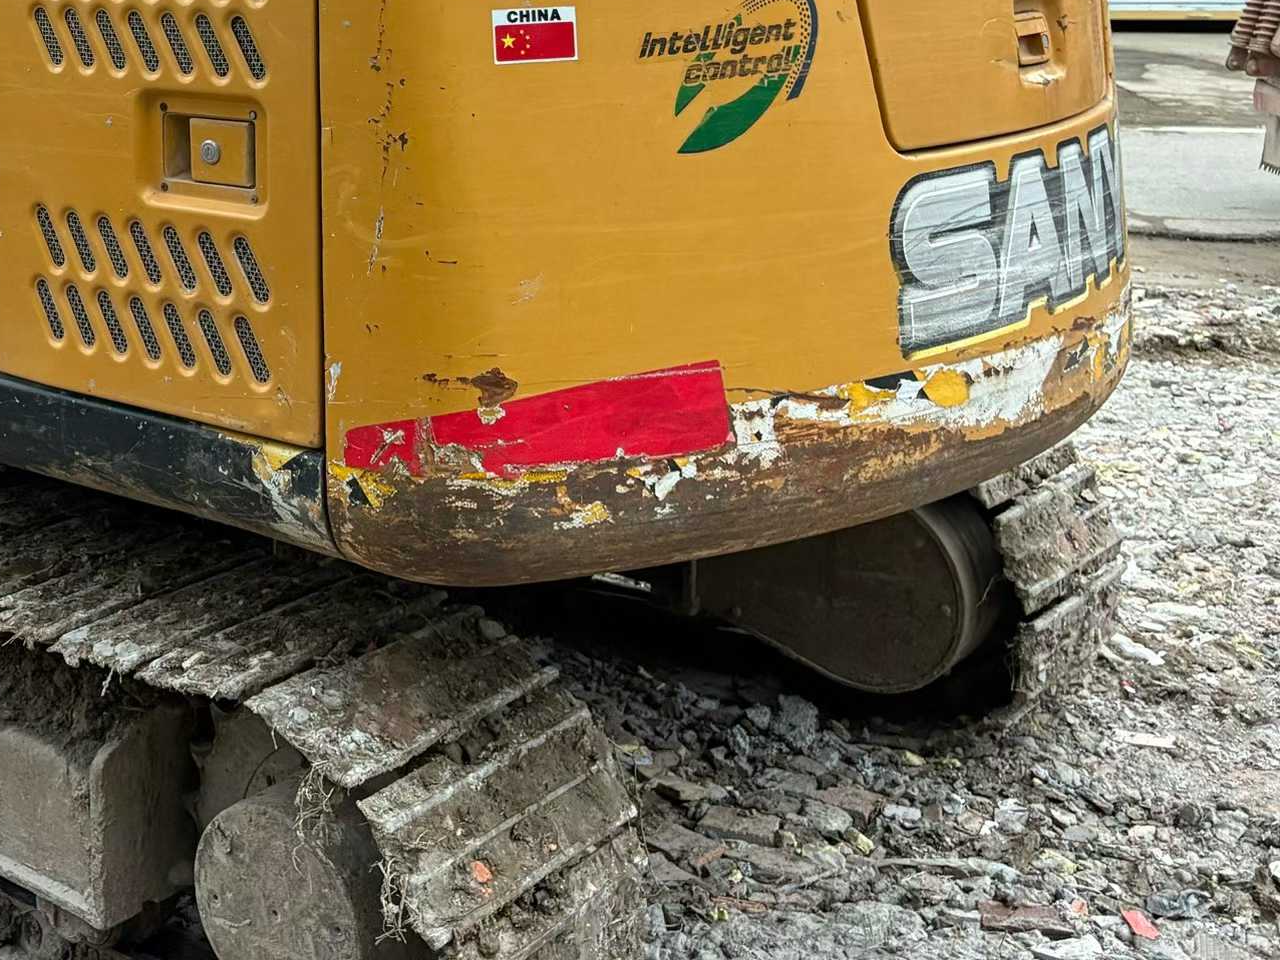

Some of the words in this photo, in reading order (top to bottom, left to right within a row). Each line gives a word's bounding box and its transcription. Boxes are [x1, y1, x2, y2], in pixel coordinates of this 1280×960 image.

[507, 8, 562, 23] CHINA
[639, 17, 797, 58] Intelligent
[683, 46, 793, 84] control
